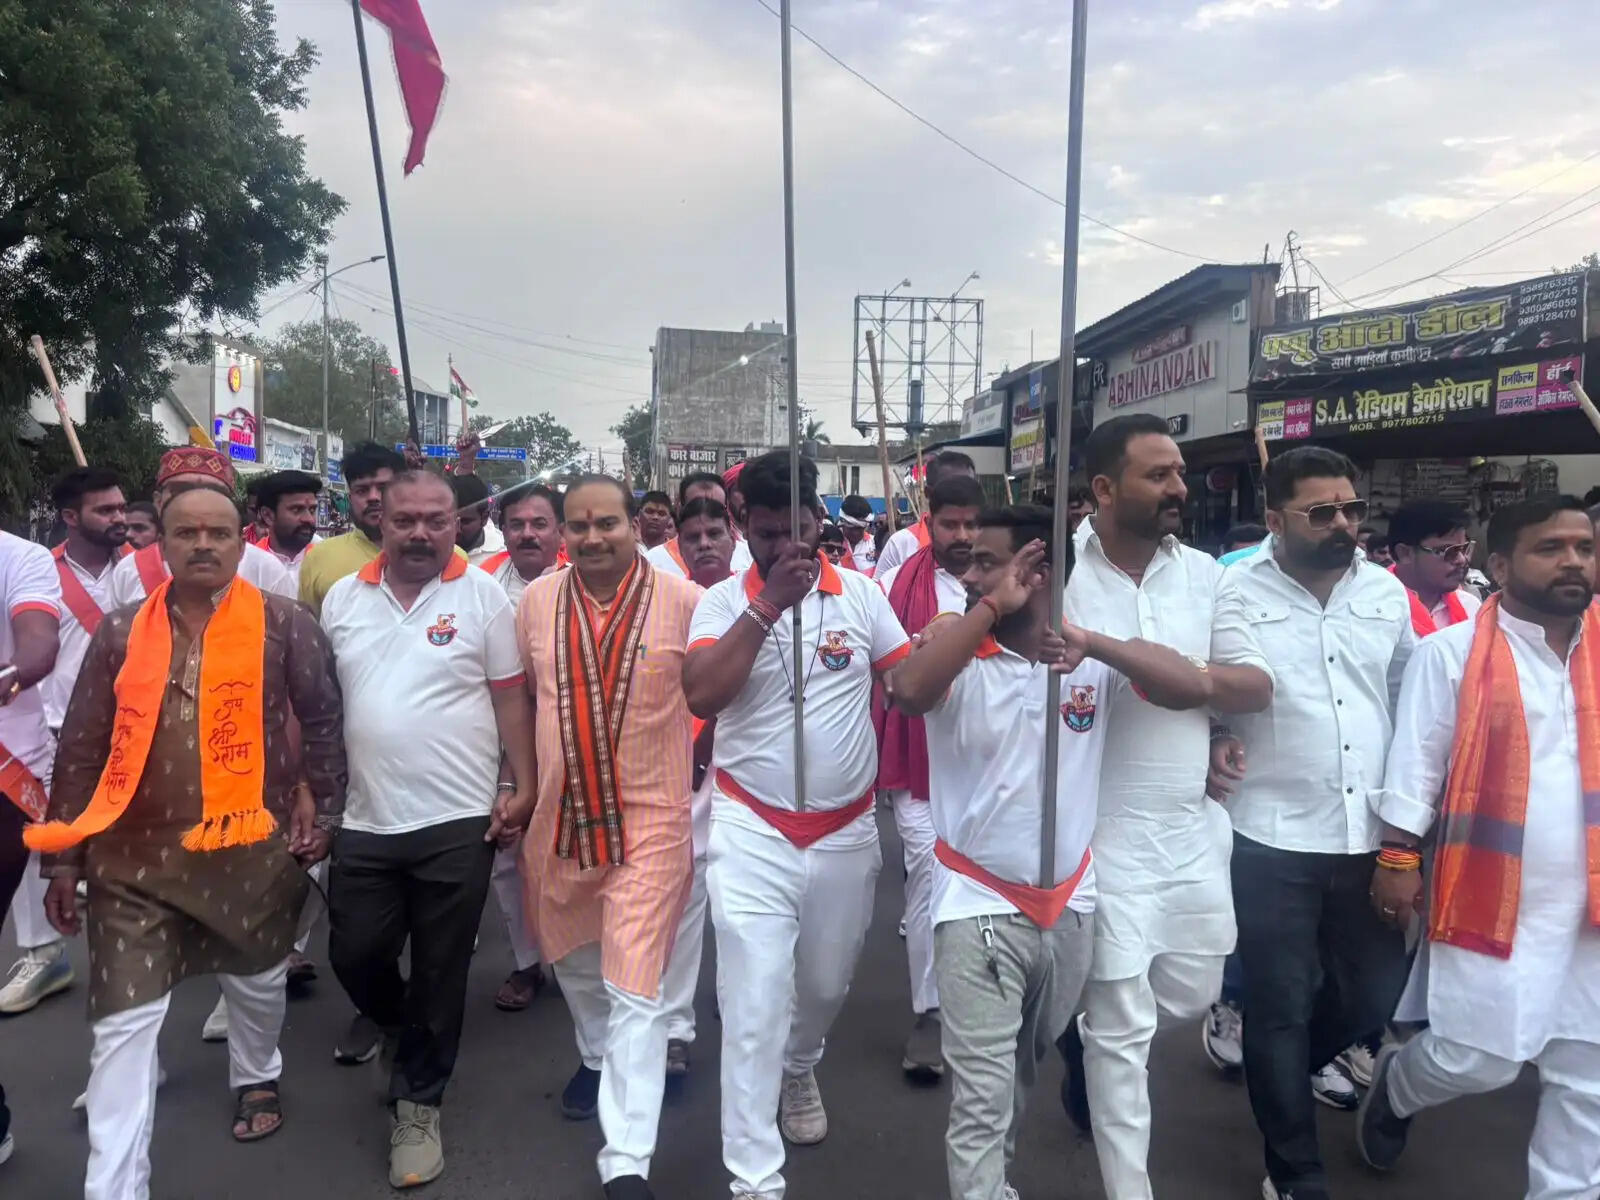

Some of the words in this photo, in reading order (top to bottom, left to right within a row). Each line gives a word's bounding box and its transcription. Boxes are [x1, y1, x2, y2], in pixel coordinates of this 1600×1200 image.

[1108, 340, 1210, 407] ABHINANDAN
[1315, 396, 1353, 426] S.A.
[1353, 389, 1410, 421] रेडियम
[1350, 422, 1375, 432] MOB.
[1382, 415, 1444, 429] 9977802715
